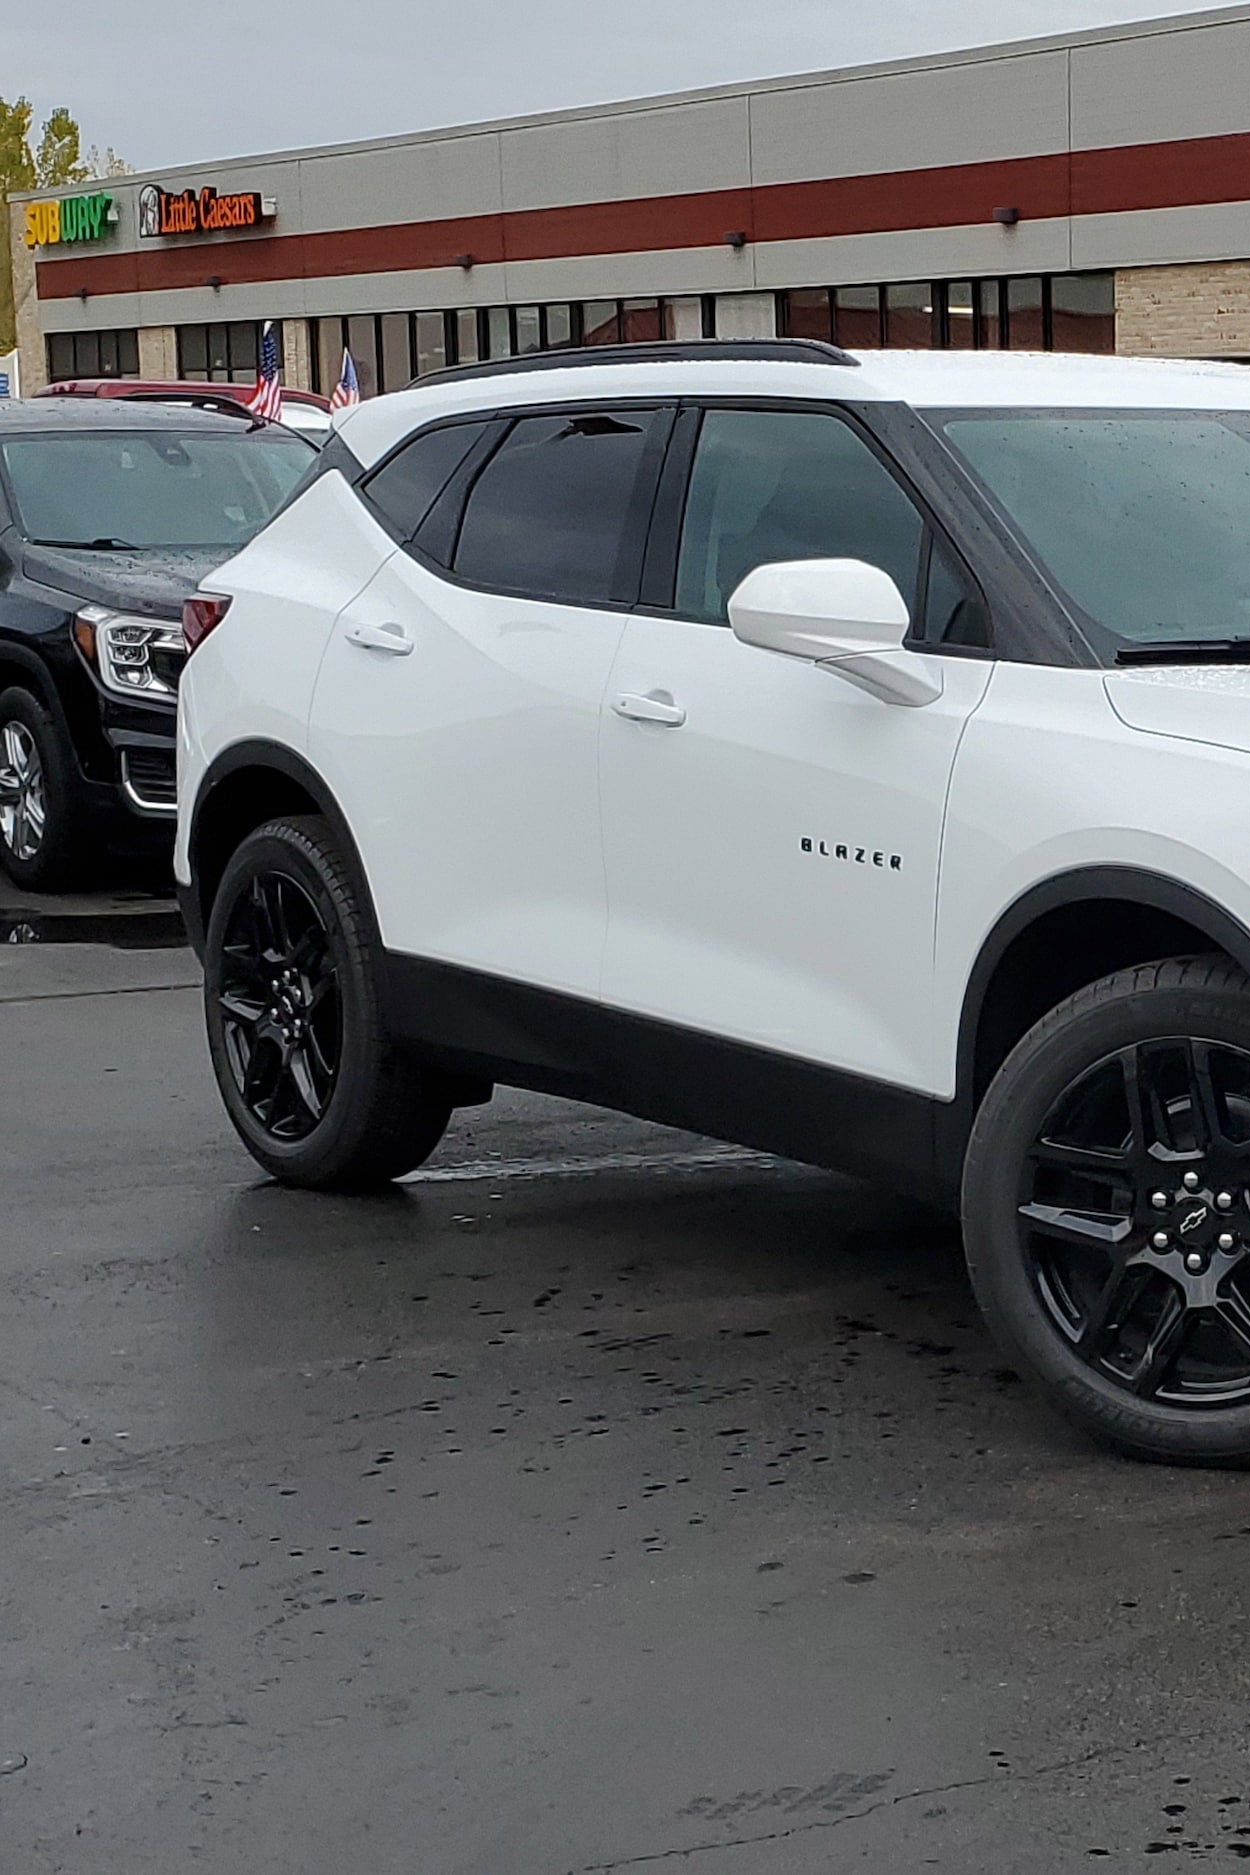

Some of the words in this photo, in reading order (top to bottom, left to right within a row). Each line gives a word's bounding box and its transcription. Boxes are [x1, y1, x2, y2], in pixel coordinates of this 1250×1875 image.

[24, 192, 112, 246] SUBWAY
[160, 191, 197, 233] Little
[200, 187, 255, 230] Caesars
[800, 837, 902, 872] BLAZER
